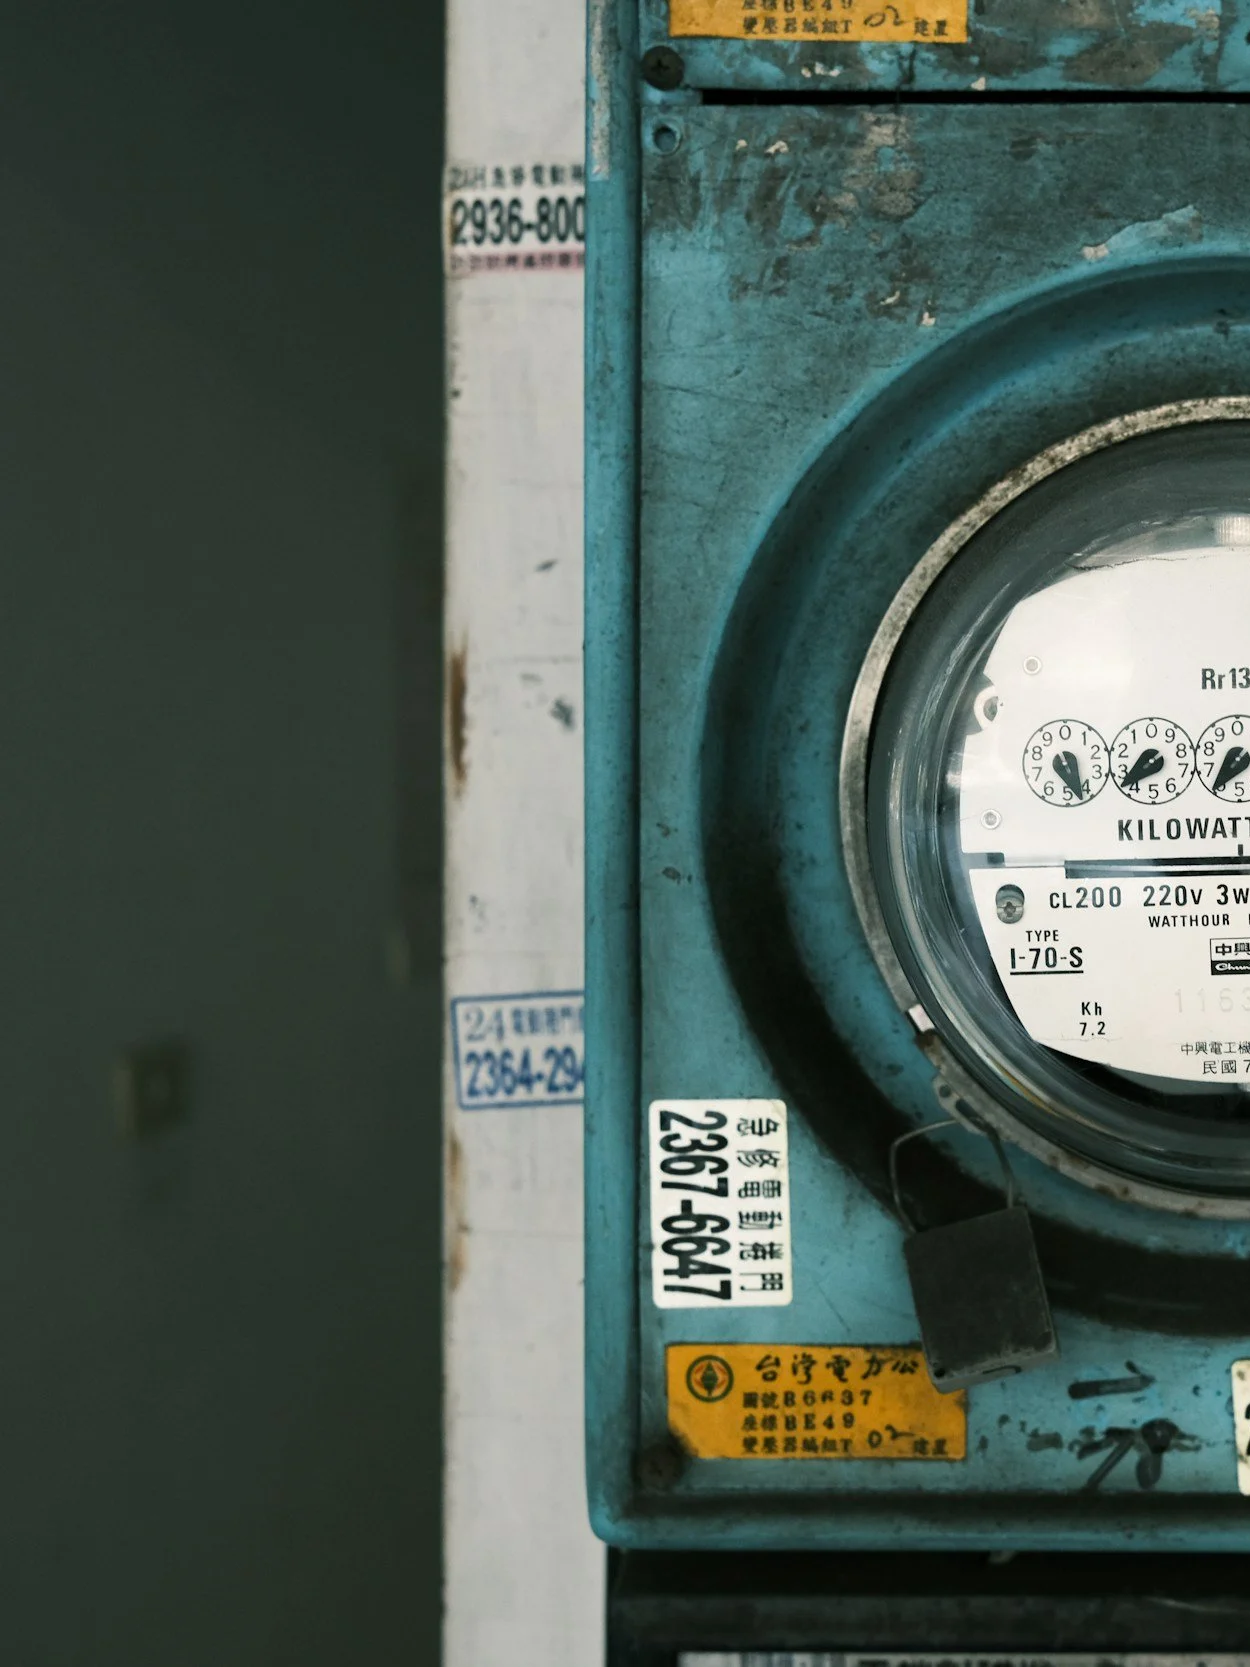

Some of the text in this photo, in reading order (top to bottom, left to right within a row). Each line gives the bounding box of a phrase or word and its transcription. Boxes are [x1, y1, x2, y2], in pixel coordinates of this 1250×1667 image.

[1131, 728, 1137, 744] 1
[1145, 723, 1158, 739] 0
[1164, 728, 1176, 744] 9
[1214, 727, 1226, 743] 9
[1231, 720, 1244, 736] 0
[1118, 742, 1129, 759] 2
[1175, 742, 1187, 759] 8
[1203, 741, 1215, 757] 8
[1031, 724, 1103, 800] 0 1 2 3 4 5 6 7 8 9
[1177, 762, 1189, 778] 7
[1203, 762, 1215, 778] 7
[1118, 764, 1128, 779] 3
[1148, 783, 1159, 800] 5
[1165, 777, 1177, 794] 6
[1234, 781, 1245, 797] 5
[1143, 885, 1203, 907] 220V
[1148, 914, 1230, 928] WATTHOUR
[1026, 930, 1059, 942] TYPE
[1010, 946, 1084, 970] I-70-S
[1081, 1002, 1102, 1016] Kh
[1079, 1022, 1106, 1036] 7.2
[464, 1046, 585, 1097] 2364-29
[659, 1109, 732, 1300] 2367-6647
[736, 1117, 784, 1291] 急修電動捲門
